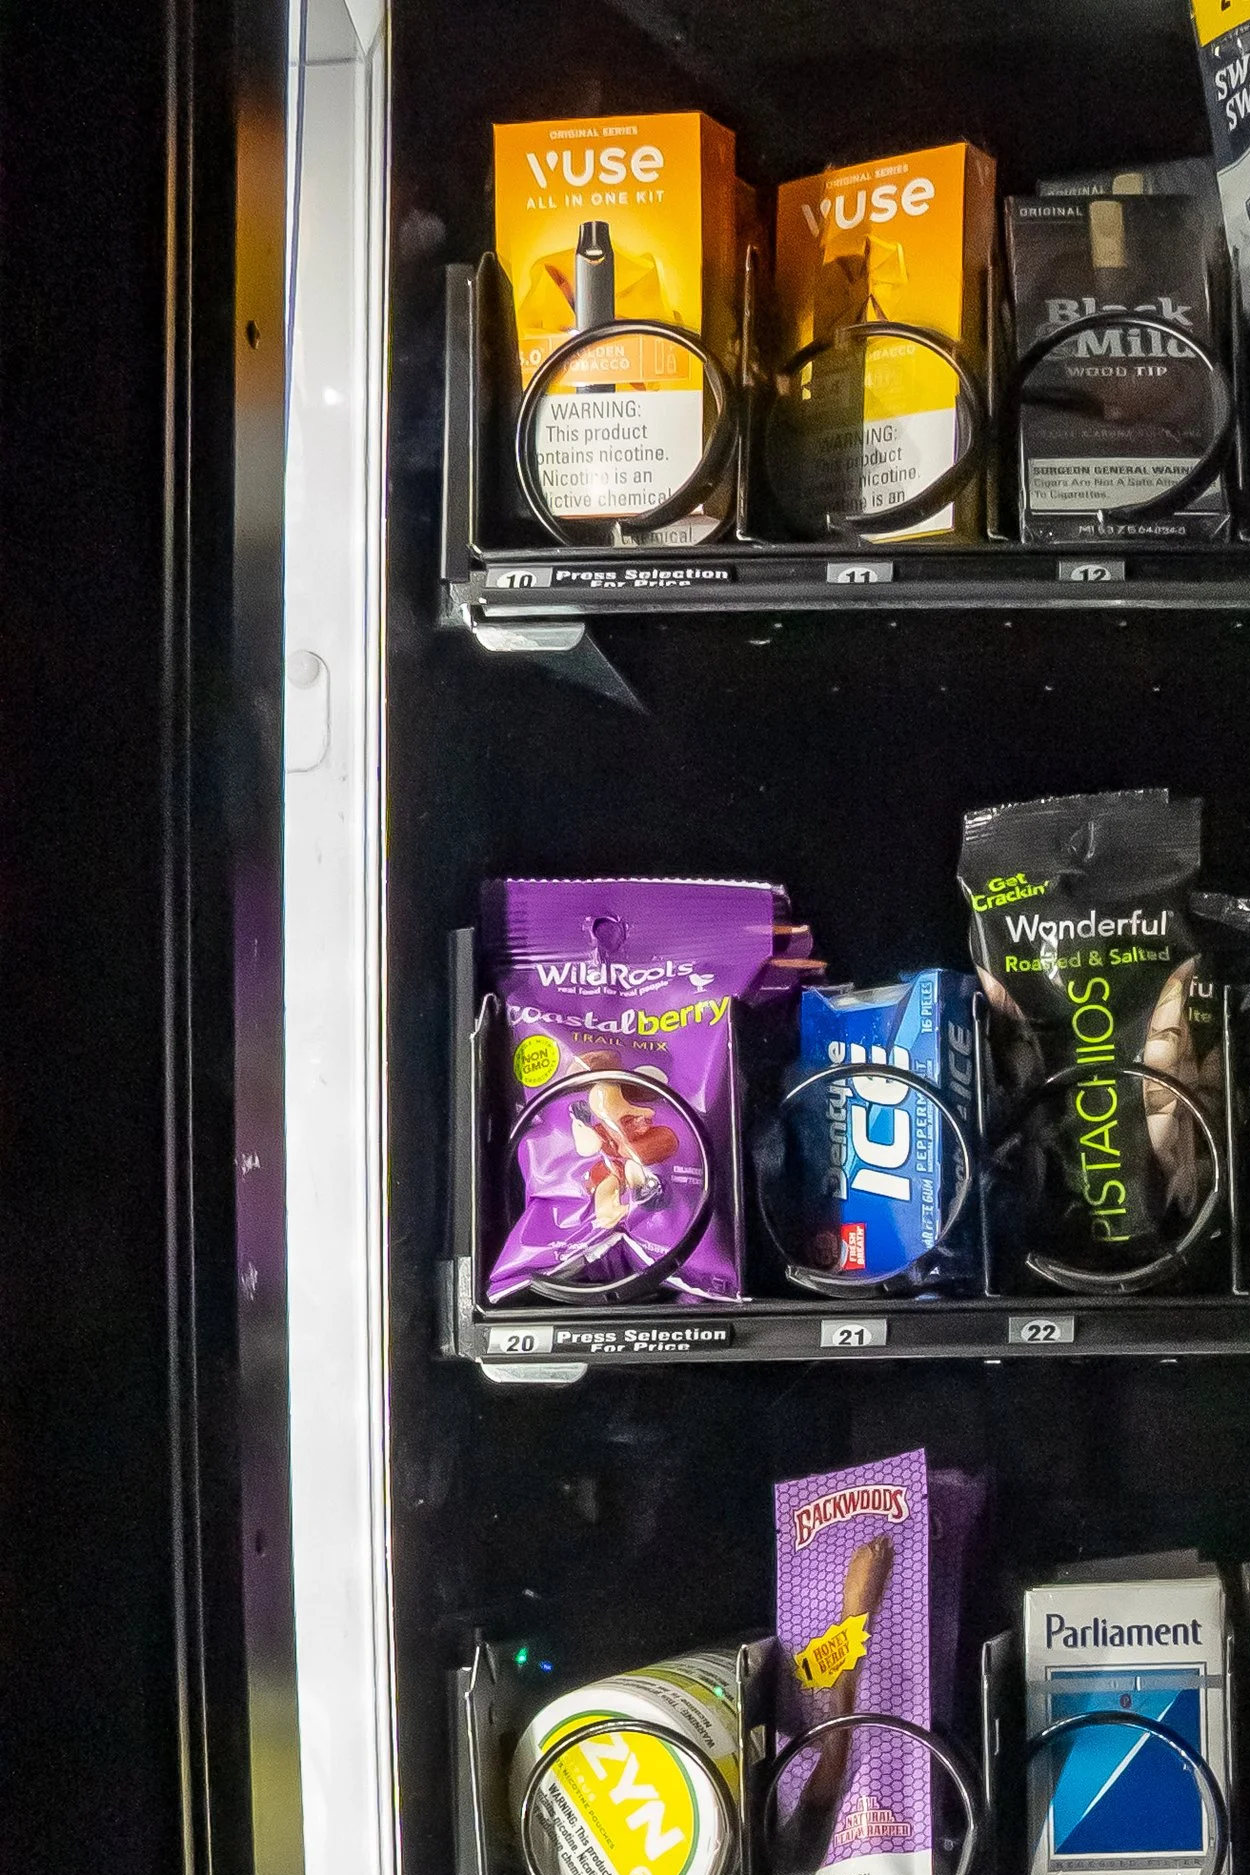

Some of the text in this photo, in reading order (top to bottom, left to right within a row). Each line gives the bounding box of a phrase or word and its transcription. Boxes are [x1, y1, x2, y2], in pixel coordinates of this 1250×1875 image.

[549, 125, 638, 140] ORIGINAL SERIES
[526, 189, 665, 210] ALL IN ONE KIT
[1019, 207, 1083, 217] ORIGINAL
[1067, 365, 1168, 377] WOOD TIP
[551, 400, 641, 421] WARNING:
[546, 425, 648, 445] This product
[600, 446, 669, 463] nicotine.
[615, 470, 652, 485] is an
[506, 569, 728, 587] 10 Press Selection
[846, 571, 870, 582] 11
[1079, 567, 1107, 581] 12
[988, 873, 1027, 892] Get
[971, 880, 1050, 912] Crackin'
[1004, 909, 1168, 943] Wonderful
[536, 962, 694, 989] WildRoots
[572, 1032, 668, 1051] TRAIL MIX
[522, 1048, 548, 1064] NON
[523, 1058, 551, 1074] GMO
[506, 1328, 726, 1353] 20 Press Selection
[838, 1328, 865, 1346] 21
[1027, 1325, 1056, 1341] 22
[590, 1342, 690, 1353] For Price
[797, 1489, 904, 1545] BACKWOODS
[1046, 1613, 1203, 1648] Parliament
[813, 1629, 848, 1659] HONEY
[576, 1730, 684, 1862] ZYN
[576, 1825, 590, 1847] This
